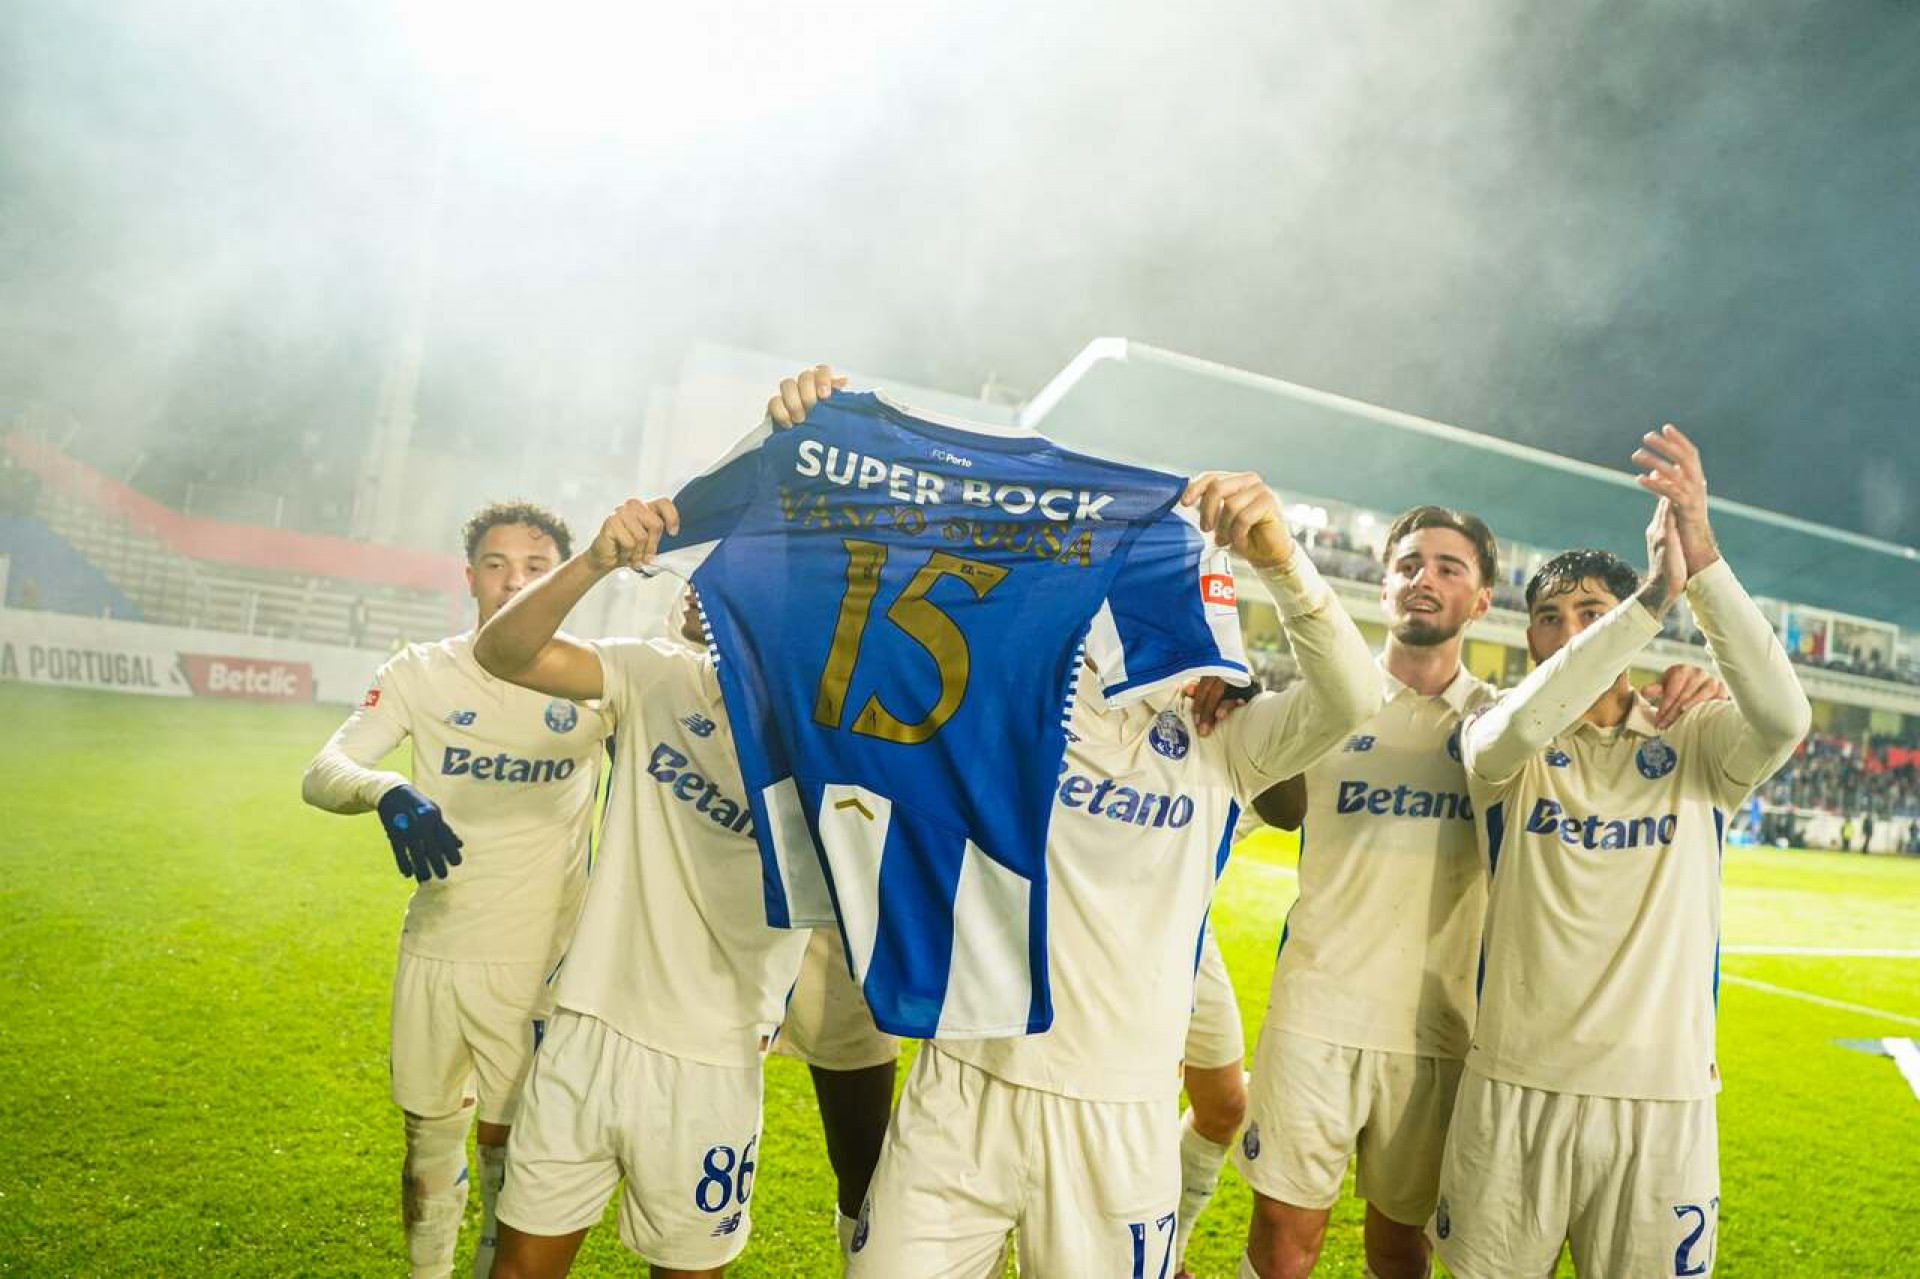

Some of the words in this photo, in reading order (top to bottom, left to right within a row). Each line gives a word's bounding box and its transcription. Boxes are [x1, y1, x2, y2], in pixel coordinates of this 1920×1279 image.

[795, 439, 946, 505] SUPER
[962, 478, 1116, 522] BOCK
[946, 452, 973, 467] Porto
[29, 646, 160, 687] PORTUGAL
[812, 537, 1014, 746] 15
[208, 662, 297, 695] Betclic
[441, 746, 577, 783] Betano
[1056, 760, 1195, 829] etano
[1337, 780, 1474, 821] Betano
[1526, 797, 1678, 850] Betano
[696, 1134, 757, 1213] 86
[1127, 1211, 1176, 1279] 17
